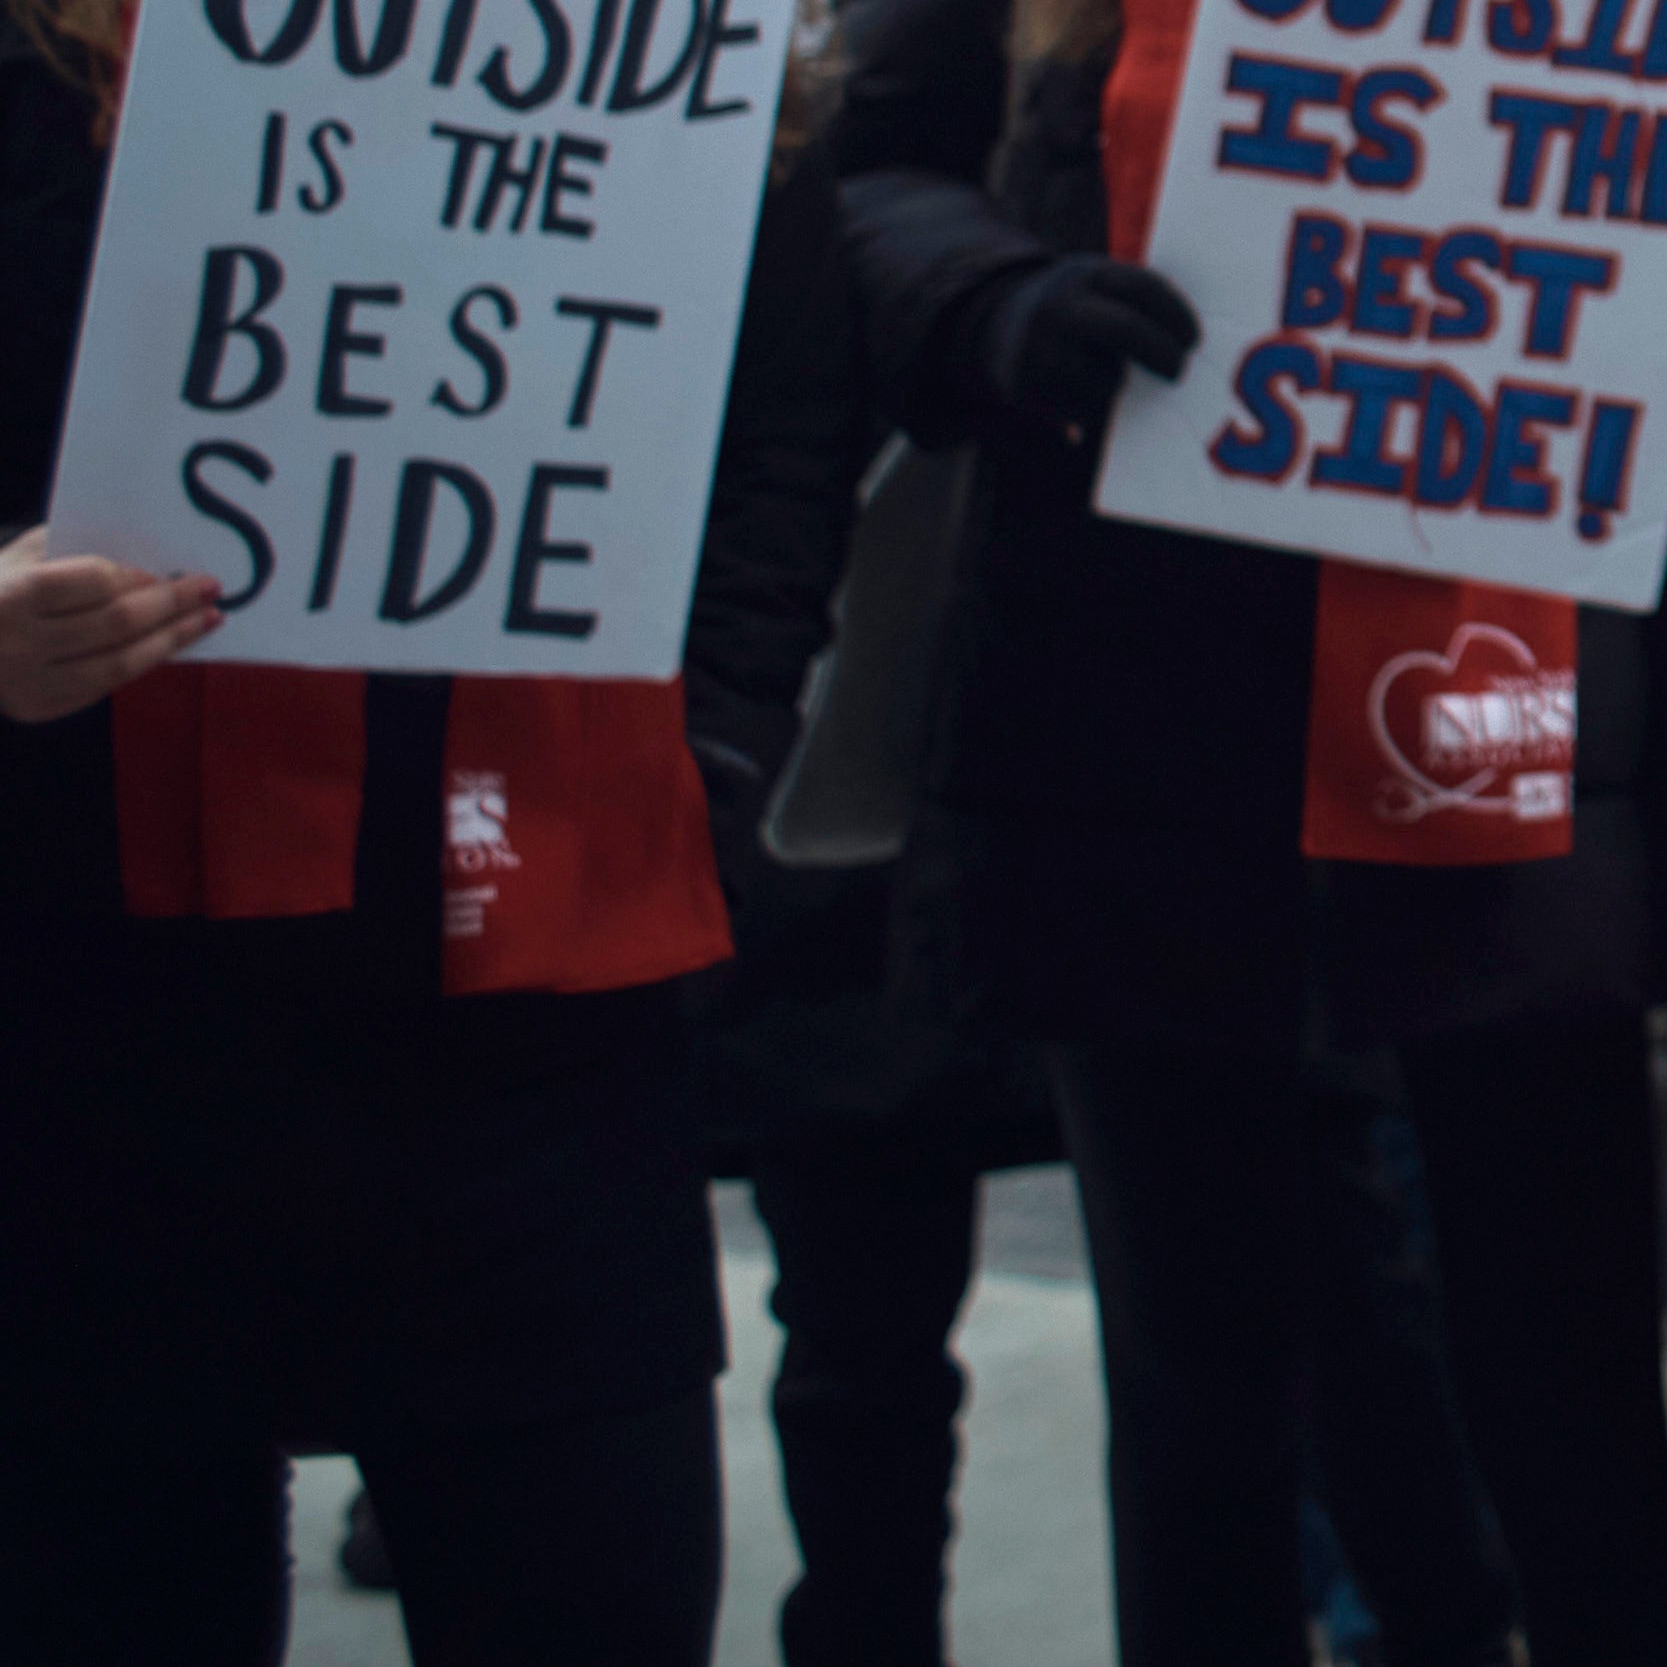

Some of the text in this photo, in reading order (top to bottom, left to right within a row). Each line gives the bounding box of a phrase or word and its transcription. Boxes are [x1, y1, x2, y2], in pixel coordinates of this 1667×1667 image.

[256, 111, 608, 239] IS THE
[1215, 50, 1448, 192] IS
[181, 244, 661, 429] BEST
[1280, 211, 1621, 363] BEST
[1208, 330, 1647, 546] SIDE!
[180, 439, 611, 639] SIDE
